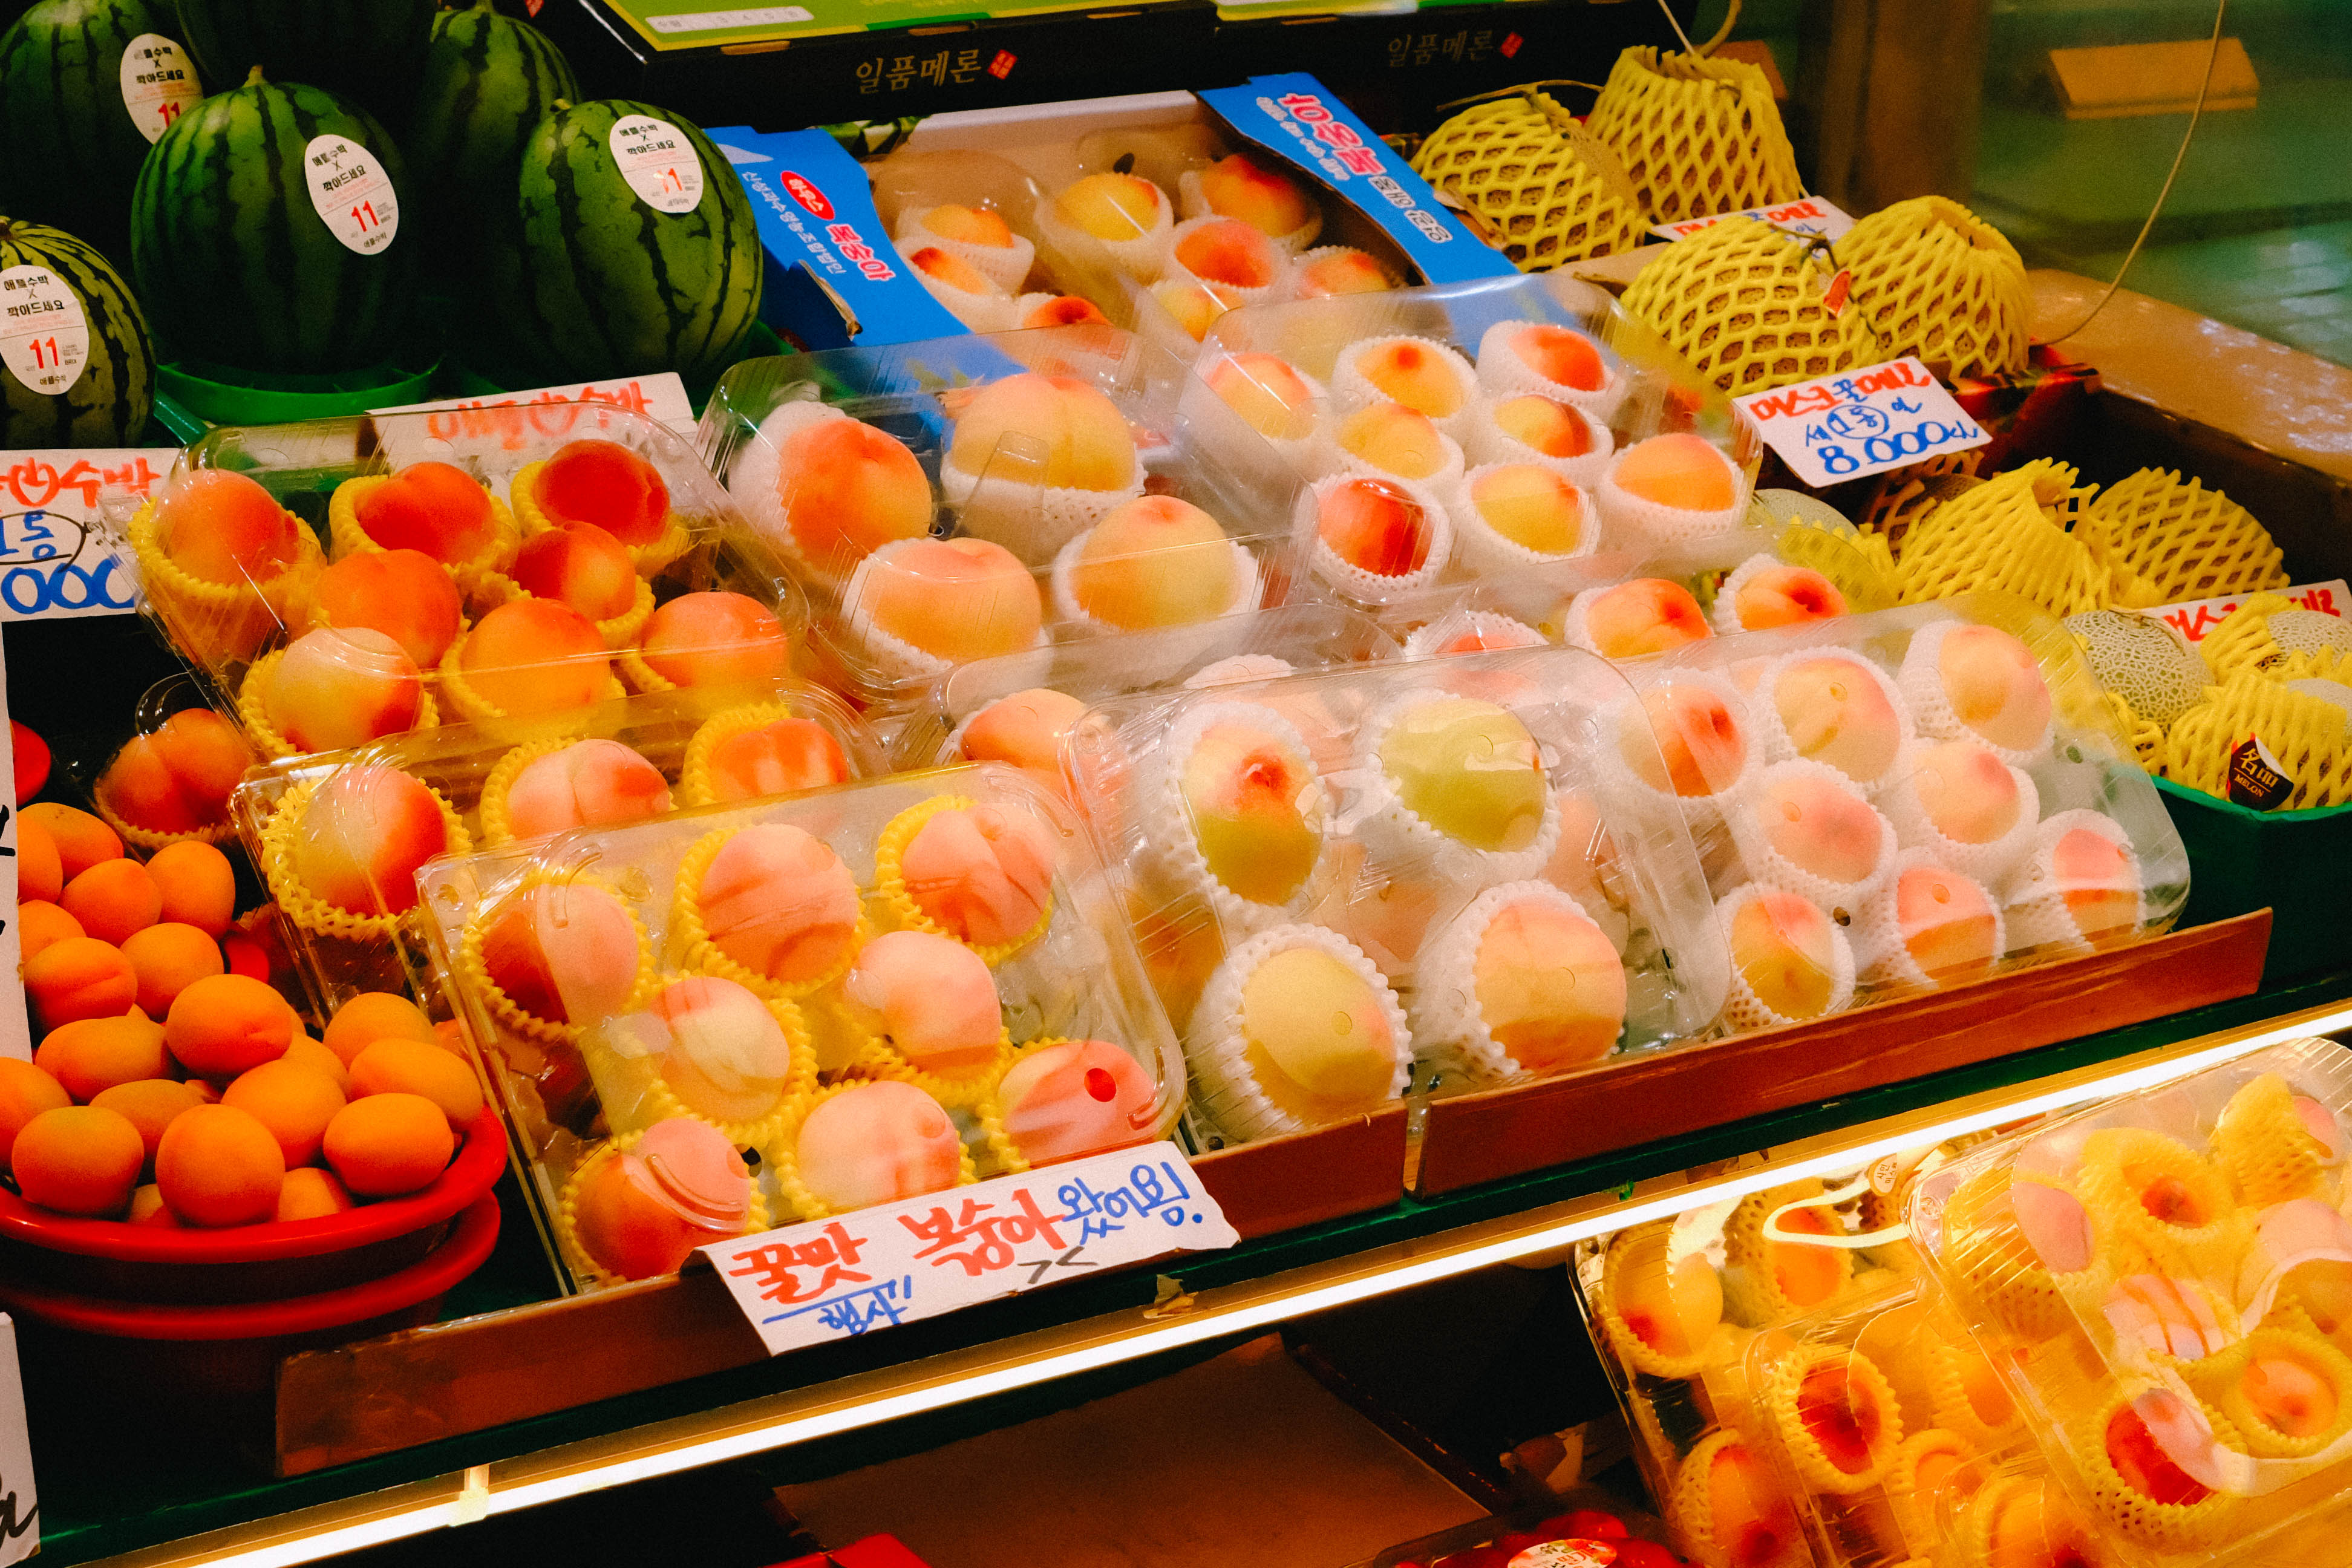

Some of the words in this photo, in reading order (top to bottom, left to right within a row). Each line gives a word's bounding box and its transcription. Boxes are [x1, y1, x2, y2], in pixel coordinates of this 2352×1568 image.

[1389, 30, 1494, 68] 일품메론
[856, 48, 982, 94] 일품메론
[158, 101, 180, 128] 11
[1277, 93, 1387, 176] 복숭아
[653, 168, 683, 194] 11
[788, 178, 825, 212] 하우스
[351, 200, 379, 232] 11
[825, 223, 896, 281] 복숭아
[4, 275, 49, 291] 애플수박
[29, 336, 59, 369] 11
[2234, 774, 2265, 797] MELON
[729, 1221, 872, 1305] 꿀맛
[897, 1188, 1067, 1276] 복숭아
